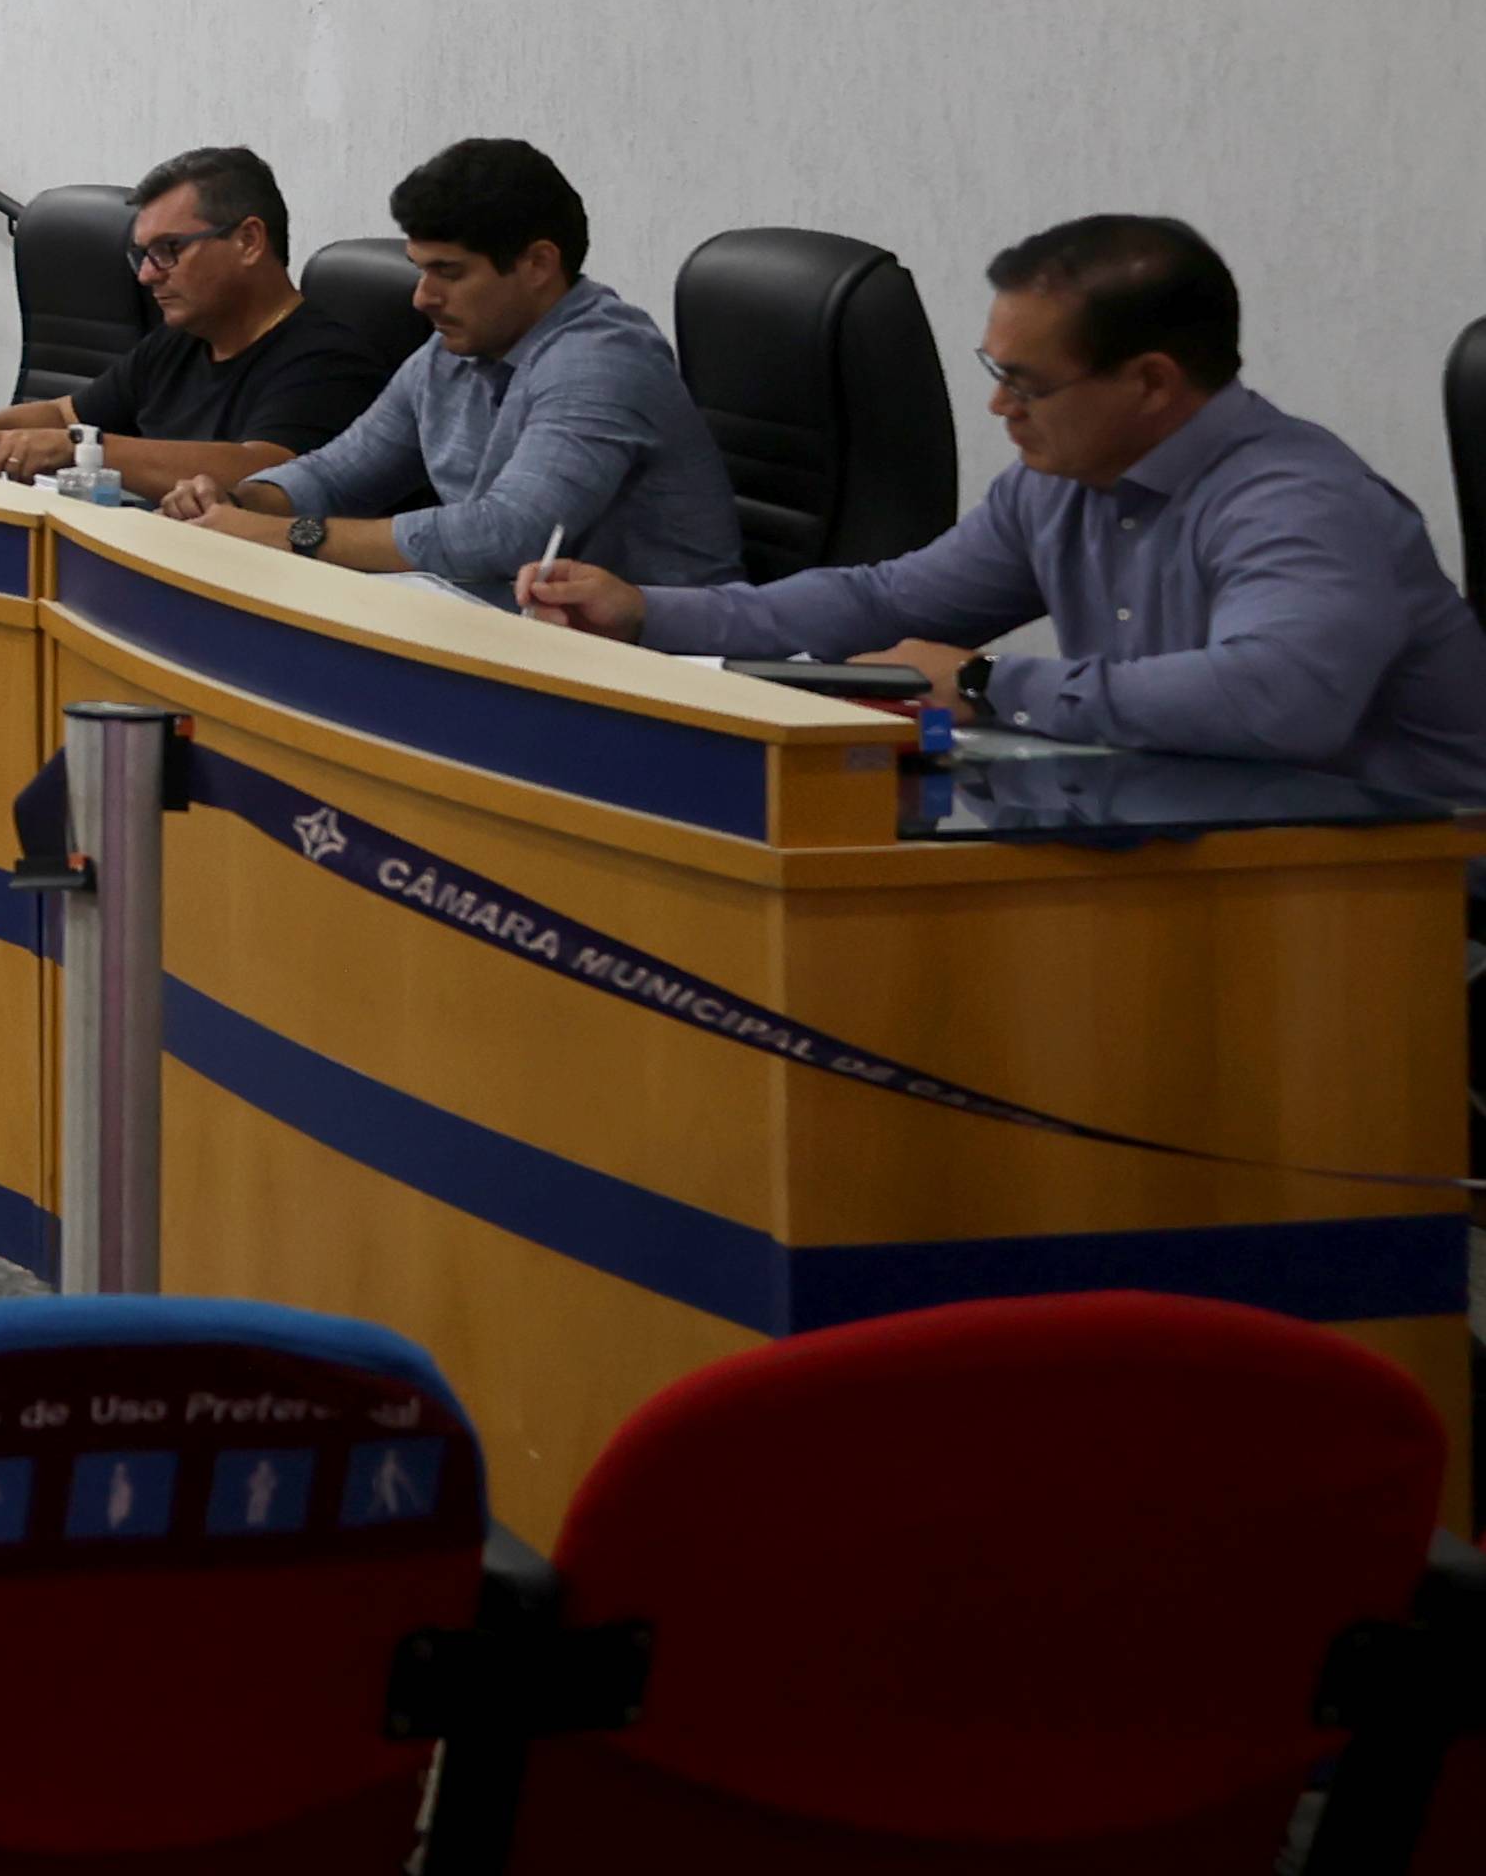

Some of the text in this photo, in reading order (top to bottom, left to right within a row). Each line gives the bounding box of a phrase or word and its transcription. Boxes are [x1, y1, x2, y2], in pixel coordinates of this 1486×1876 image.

[376, 856, 561, 961] CÂMARA
[570, 946, 816, 1061] MUNICIPAL
[18, 1398, 71, 1430] de
[90, 1394, 169, 1426] Uso
